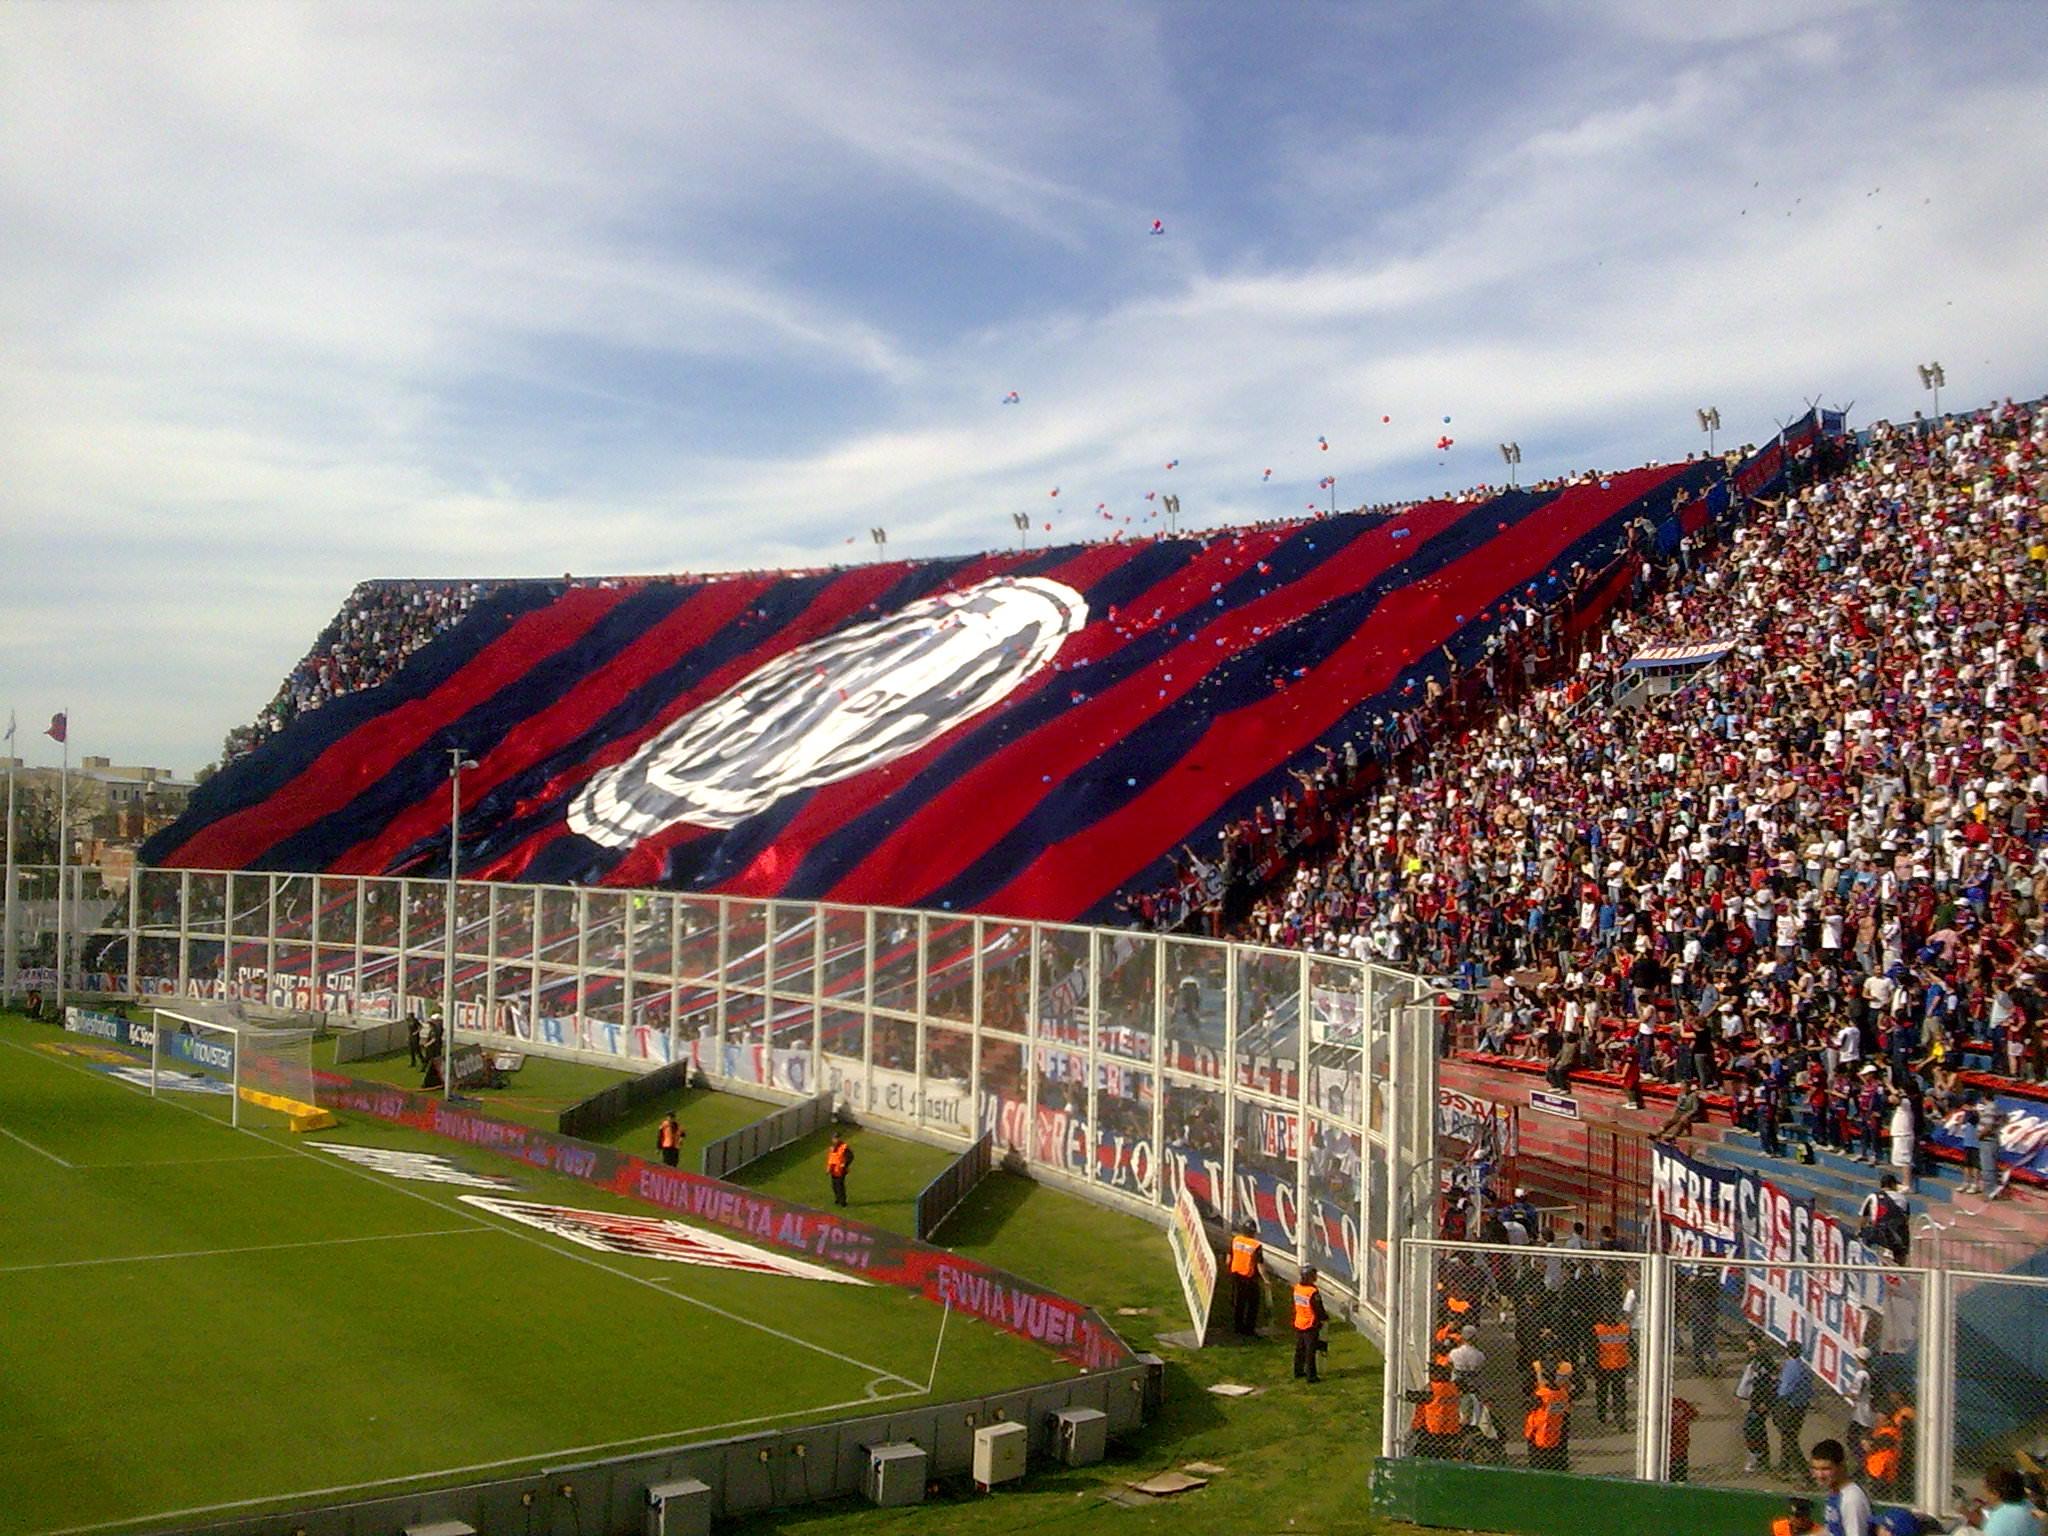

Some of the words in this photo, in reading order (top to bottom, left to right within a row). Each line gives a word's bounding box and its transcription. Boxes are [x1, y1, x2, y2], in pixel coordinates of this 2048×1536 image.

[271, 988, 349, 1016] CARZA
[456, 1003, 506, 1033] CELIA
[886, 1083, 904, 1112] El
[1259, 1109, 1319, 1161] VAREA
[639, 1169, 689, 1208] ENVIA
[694, 1186, 772, 1238] VUELTA
[778, 1212, 807, 1249] AL
[1652, 1149, 1736, 1242] MERLO
[938, 1264, 1006, 1323] ENVIA
